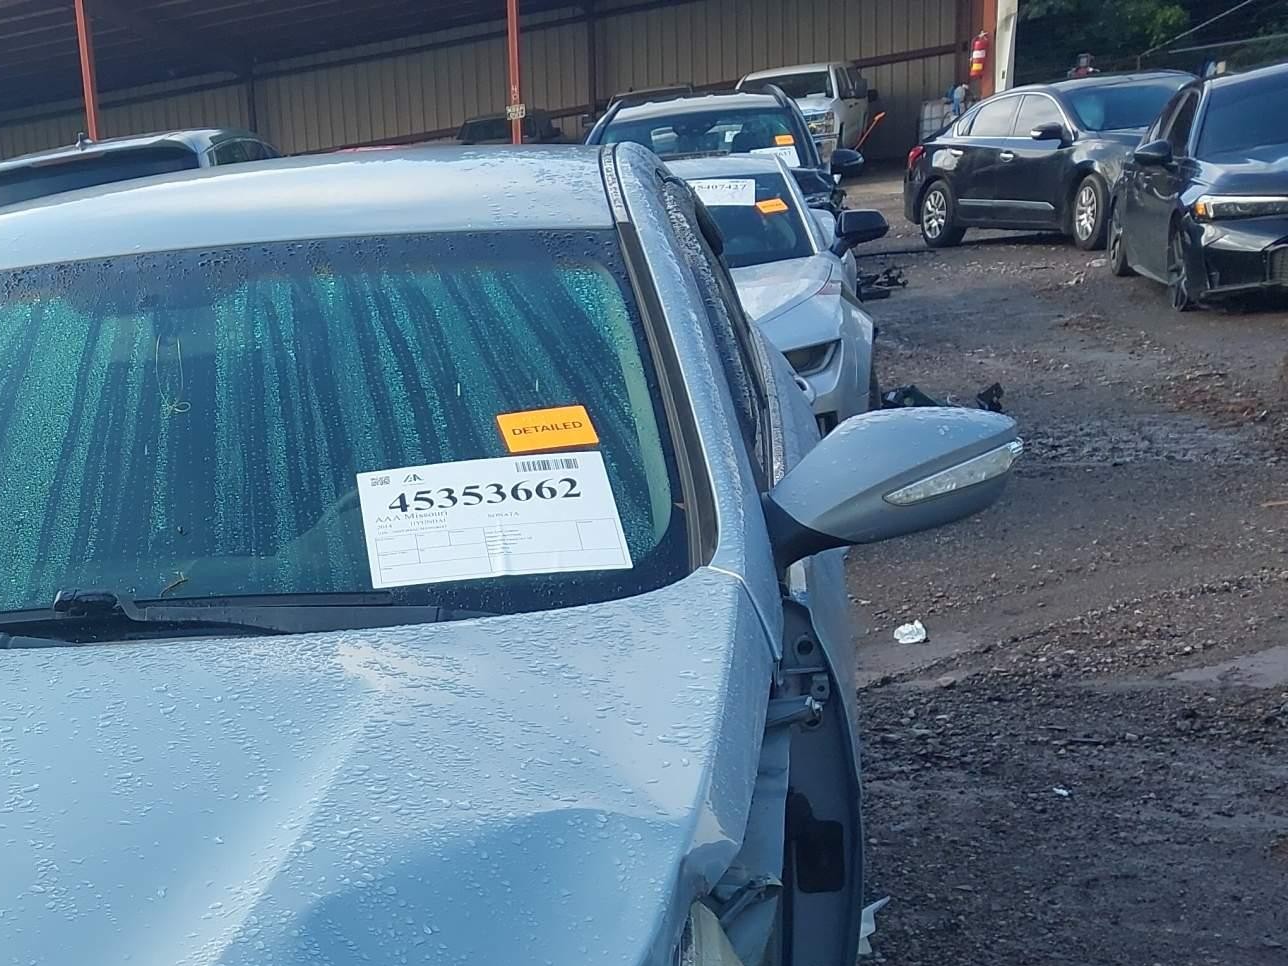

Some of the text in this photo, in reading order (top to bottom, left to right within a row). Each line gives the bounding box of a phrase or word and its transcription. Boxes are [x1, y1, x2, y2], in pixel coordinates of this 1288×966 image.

[512, 420, 583, 436] DETAILED
[388, 477, 582, 513] 45353662
[376, 511, 448, 523] AAA Missouri
